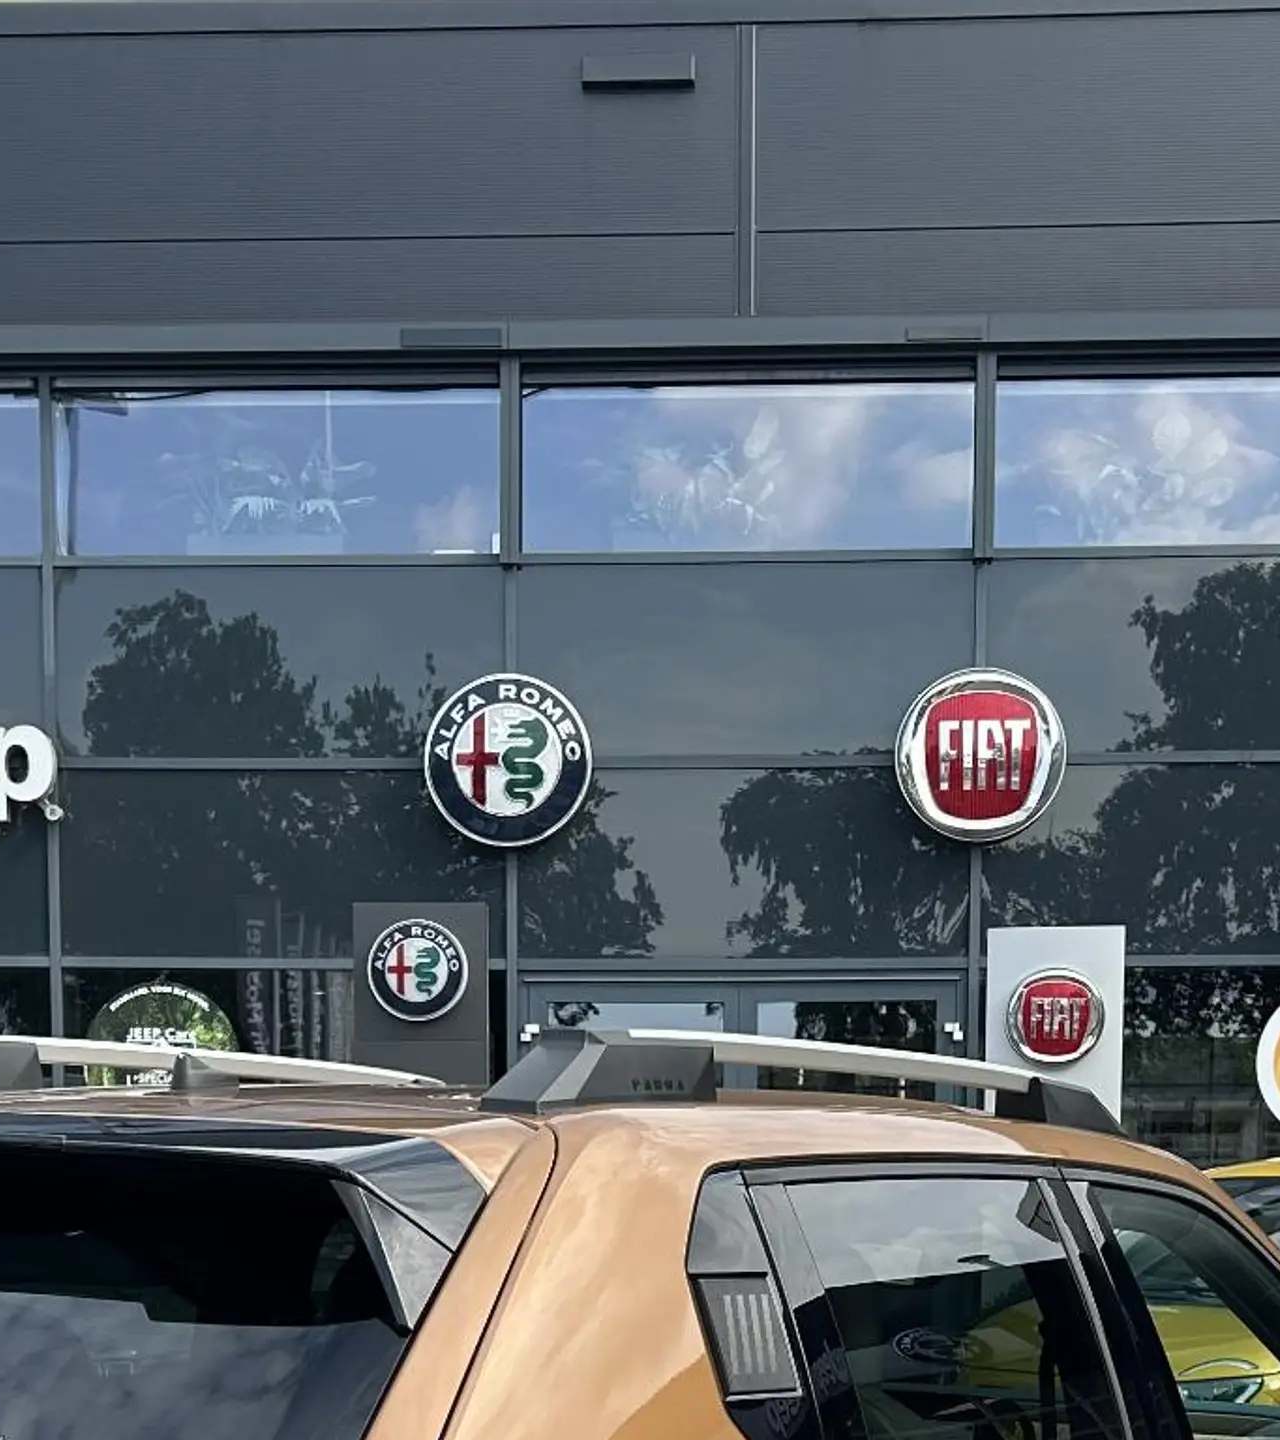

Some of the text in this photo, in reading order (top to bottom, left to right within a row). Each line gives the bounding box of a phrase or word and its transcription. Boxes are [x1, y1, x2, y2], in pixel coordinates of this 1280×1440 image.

[433, 683, 582, 762] ALFA ROMEO
[937, 718, 1031, 791] FIAT
[373, 925, 460, 972] ALFA ROMEO
[1029, 995, 1088, 1041] FIAT
